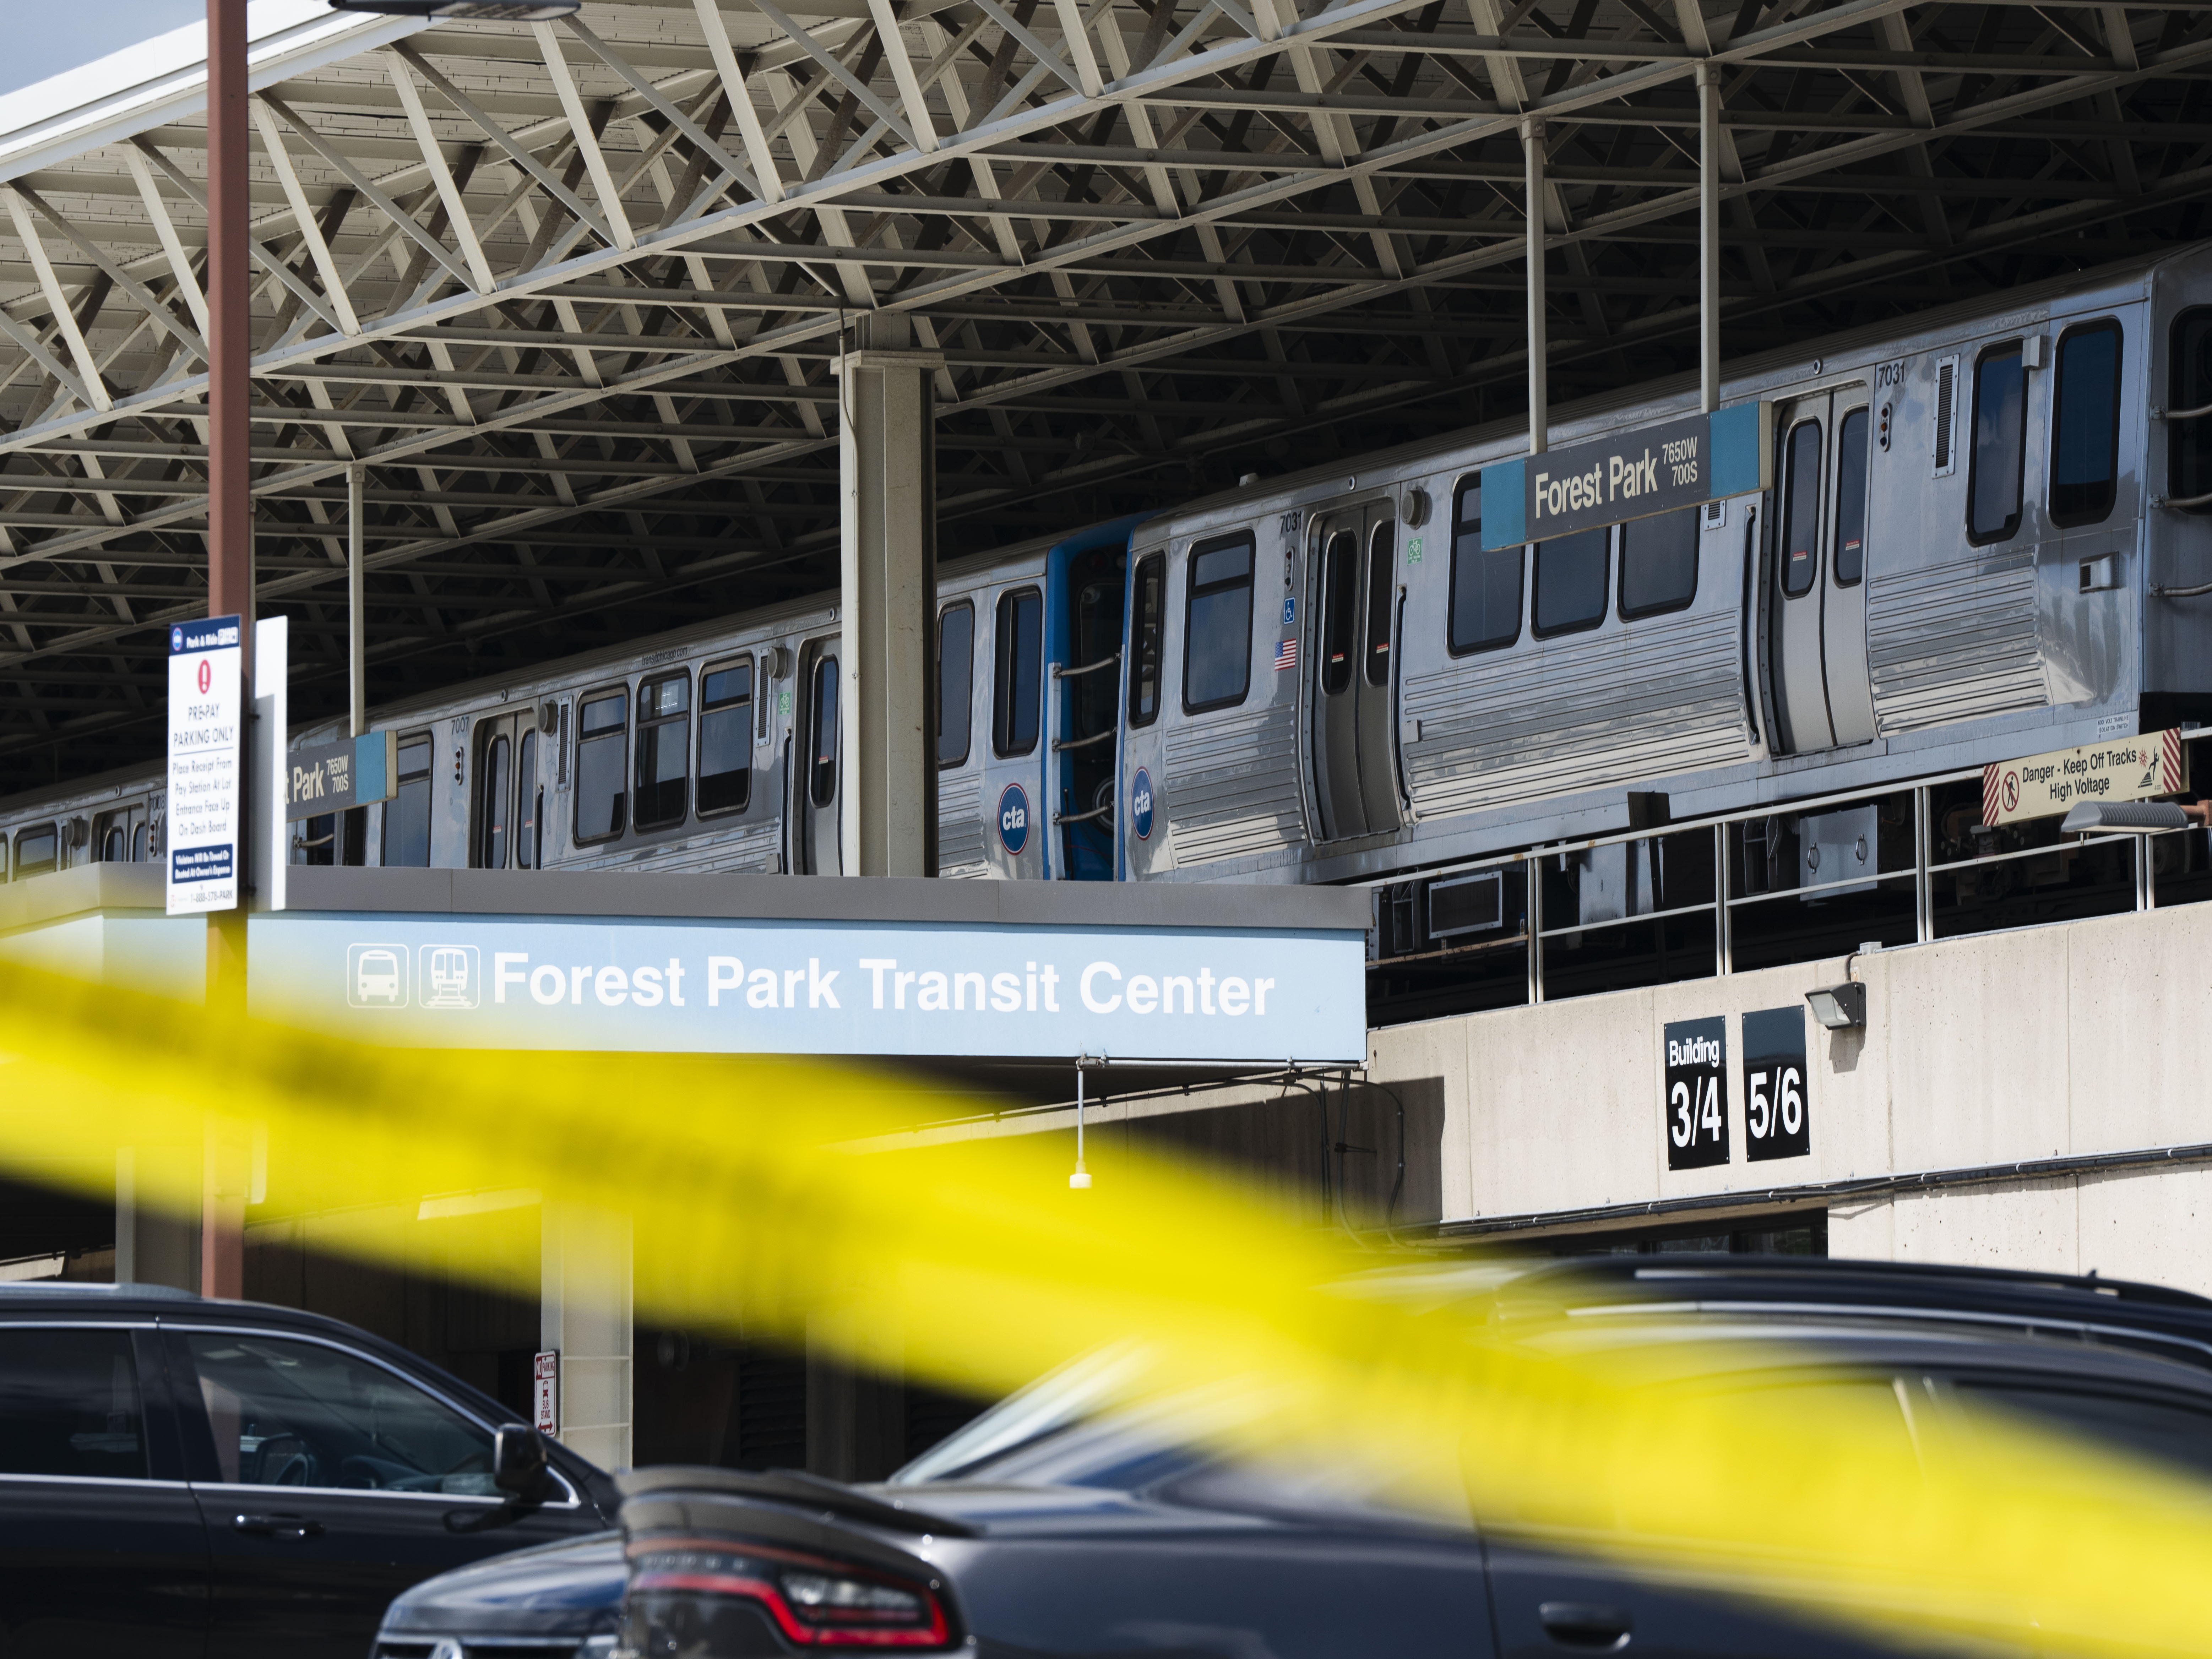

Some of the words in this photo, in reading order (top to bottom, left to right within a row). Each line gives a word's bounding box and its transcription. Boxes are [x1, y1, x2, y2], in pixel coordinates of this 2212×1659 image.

[1879, 361, 1905, 388] 7031
[1662, 436, 1698, 465] 7650W
[1535, 462, 1602, 518] Forest
[1609, 448, 1658, 502] Park
[1672, 461, 1697, 487] 700S
[1280, 511, 1302, 534] 7031
[187, 635, 199, 649] Park
[642, 647, 687, 666] transitchicago.com
[174, 729, 210, 747] PARKING
[213, 725, 233, 742] ONLY
[451, 716, 469, 735] 7007
[173, 762, 189, 774] Place
[191, 759, 214, 774] Receipt
[216, 757, 232, 769] From
[326, 755, 349, 776] 7650W
[2023, 763, 2054, 784] Danger
[2064, 757, 2087, 777] Keep
[2090, 752, 2104, 771] Off
[2107, 747, 2137, 767] Tracks
[175, 783, 186, 797] Pay
[189, 780, 210, 794] Station
[213, 779, 220, 790] At
[222, 777, 231, 789] Lot
[293, 763, 324, 803] Park
[332, 773, 349, 794] 700S
[2050, 783, 2072, 802] High
[2075, 776, 2110, 795] Voltage
[149, 794, 165, 813] 7008
[176, 803, 202, 816] Entrance
[205, 800, 218, 812] Face
[221, 798, 230, 815] Up
[1133, 789, 1150, 816] cta
[179, 824, 187, 836] On
[190, 821, 206, 834] Dash
[208, 818, 226, 832] Board
[1002, 806, 1025, 830] cta
[176, 854, 194, 865] Violators
[195, 852, 203, 863] Will
[190, 867, 195, 877] At
[191, 889, 233, 903] 1-888-578-PARK
[494, 952, 685, 1007] Forest
[708, 955, 841, 1009] Park
[859, 958, 1060, 1012] Transit
[1080, 961, 1275, 1016] Center
[1669, 1036, 1719, 1068] Building
[1672, 1076, 1721, 1148] 3/4
[1750, 1066, 1802, 1139] 5/6
[536, 1360, 542, 1376] NO
[542, 1361, 554, 1373] PARKING
[541, 1409, 550, 1420] STAND
